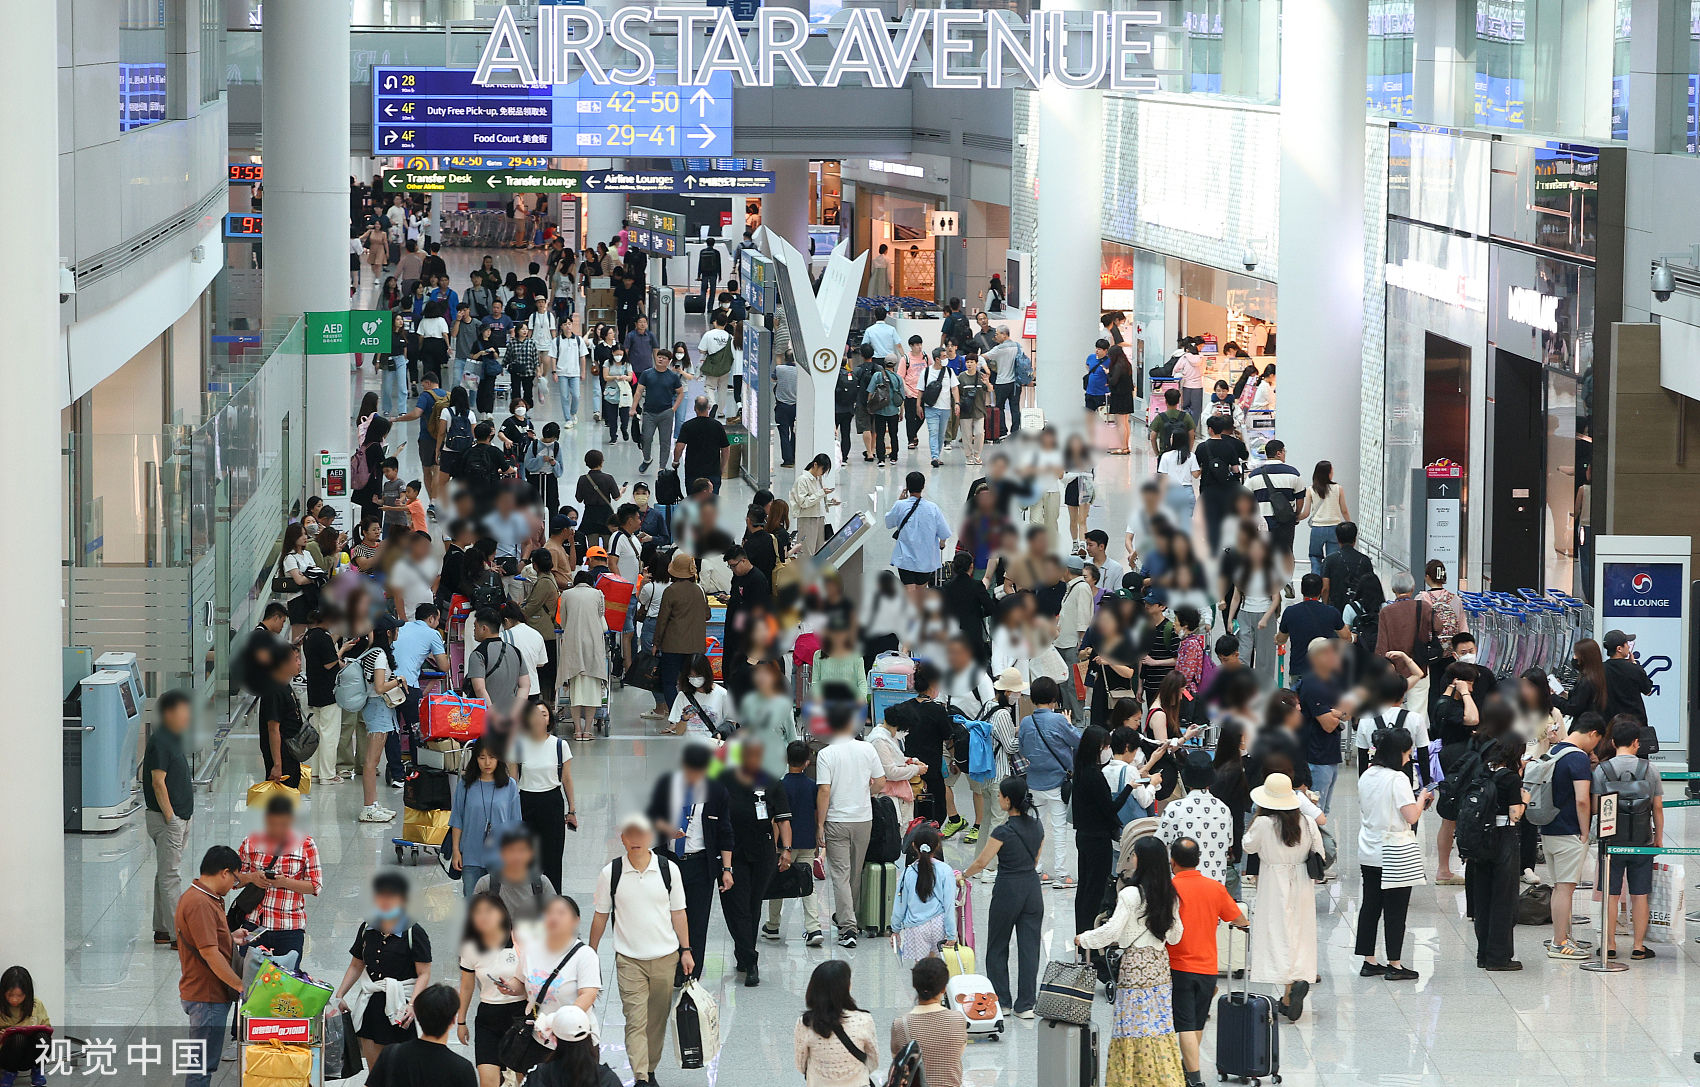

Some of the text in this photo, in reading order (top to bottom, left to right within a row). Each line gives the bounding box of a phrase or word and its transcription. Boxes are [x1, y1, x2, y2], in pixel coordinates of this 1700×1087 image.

[472, 5, 1162, 90] AIRSTAR AVENUE
[401, 74, 416, 86] 28
[606, 90, 679, 113] 42-50
[401, 102, 416, 114] 4F
[427, 106, 446, 117] Duty
[447, 106, 465, 115] Free
[401, 130, 416, 142] 4F
[473, 133, 496, 143] Food
[522, 134, 548, 144] 美食街
[606, 124, 676, 146] 29-41
[451, 156, 483, 167] 42-50
[507, 156, 538, 167] 29-41
[406, 174, 472, 183] Transfer Desk
[505, 175, 577, 188] Transfer Lounge
[604, 174, 674, 186] Airline Lounges
[322, 324, 343, 334] AED
[360, 337, 380, 346] AED
[1614, 599, 1670, 607] KAL LOUNGE
